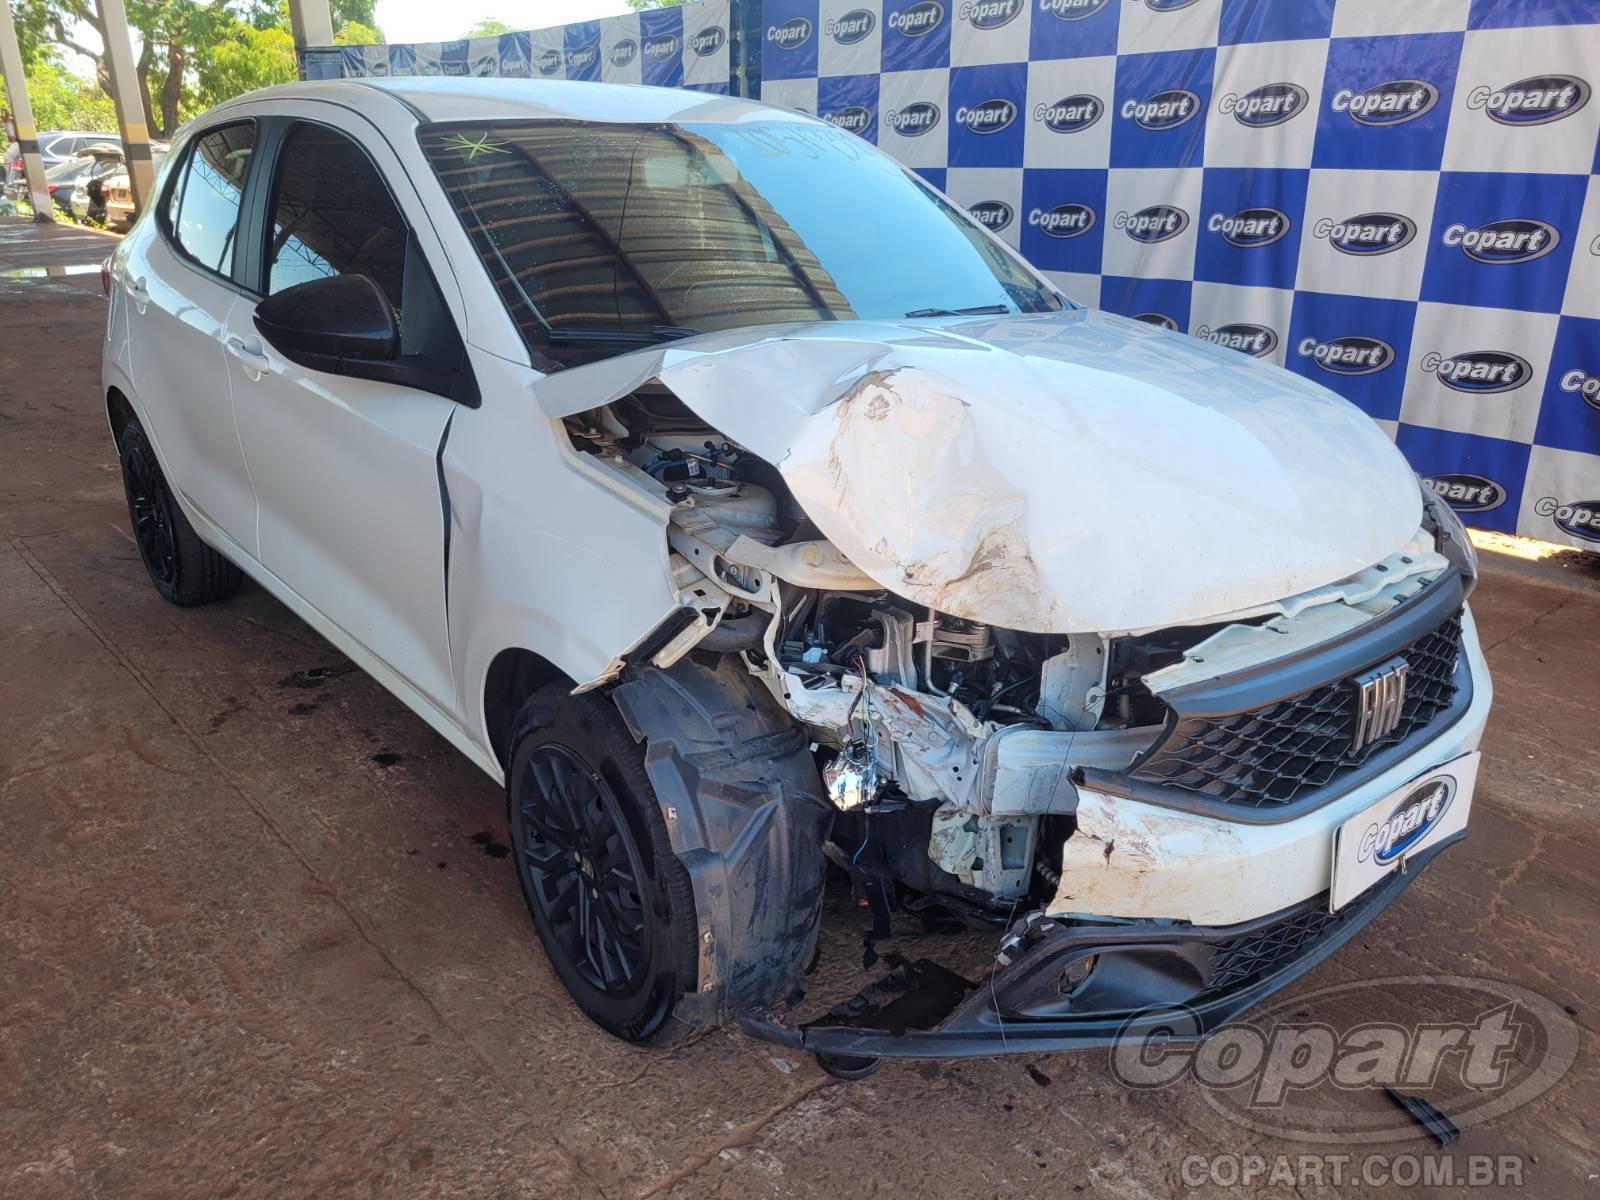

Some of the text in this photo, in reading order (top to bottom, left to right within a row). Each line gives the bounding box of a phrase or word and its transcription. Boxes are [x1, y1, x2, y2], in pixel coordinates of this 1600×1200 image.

[888, 9, 937, 31] Copart
[959, 0, 1016, 24] Copart
[767, 24, 807, 42] Copart
[825, 18, 869, 38] Copart
[644, 38, 674, 57] Copart
[686, 29, 719, 53] Copart
[604, 46, 632, 62] Copart
[1121, 95, 1190, 122] Copart
[1218, 91, 1297, 115] Copart
[1332, 87, 1427, 117] Copart
[1466, 83, 1576, 117] Copart
[824, 113, 867, 129] Copart
[885, 110, 934, 131] Copart
[955, 105, 1011, 127] Copart
[1033, 100, 1093, 126] Copart
[1028, 207, 1088, 229] Copart
[1113, 211, 1176, 234] Copart
[1207, 213, 1282, 236] Copart
[1313, 216, 1405, 246] Copart
[1442, 225, 1546, 253] Copart
[1197, 325, 1265, 350] Copart
[1298, 338, 1384, 367] Copart
[1421, 352, 1519, 384] Copart
[1350, 655, 1410, 757] FIAT
[1357, 780, 1446, 863] Copart
